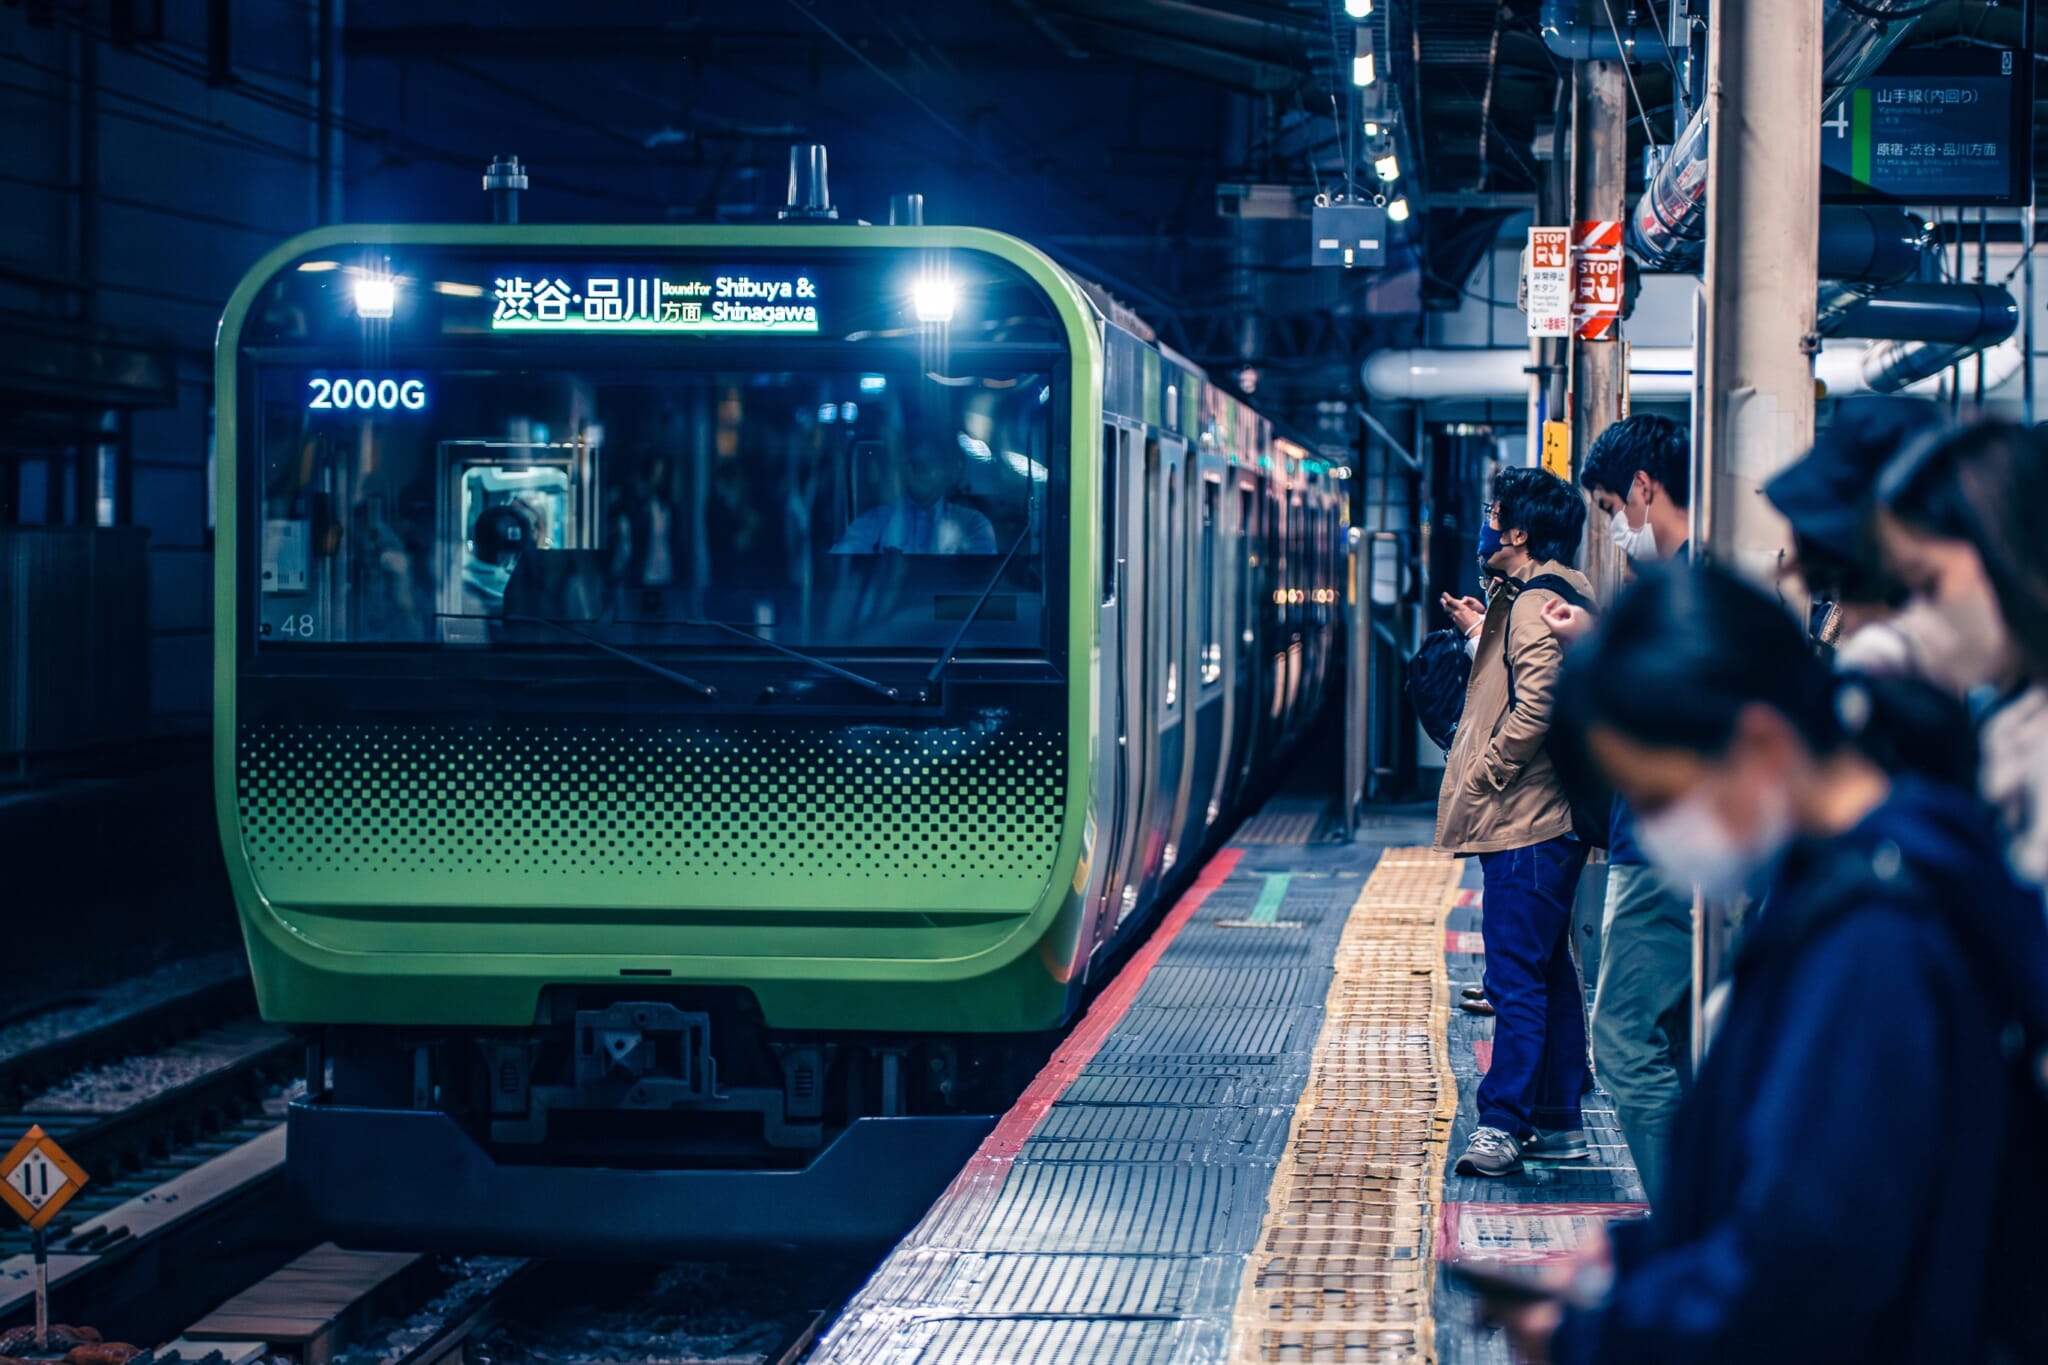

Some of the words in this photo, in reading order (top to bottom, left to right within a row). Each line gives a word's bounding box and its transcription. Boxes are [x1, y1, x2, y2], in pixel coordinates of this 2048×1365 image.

[1535, 233, 1565, 244] STOP
[1579, 261, 1618, 274] STOP
[493, 277, 661, 322] 渋谷・品川
[661, 301, 702, 322] 方面
[662, 281, 692, 296] Bound
[694, 281, 712, 296] for
[715, 277, 792, 302] Shibuya
[796, 277, 816, 298] &
[712, 301, 816, 326] Shinagawa
[308, 378, 426, 410] 2000G
[280, 613, 315, 637] 48
